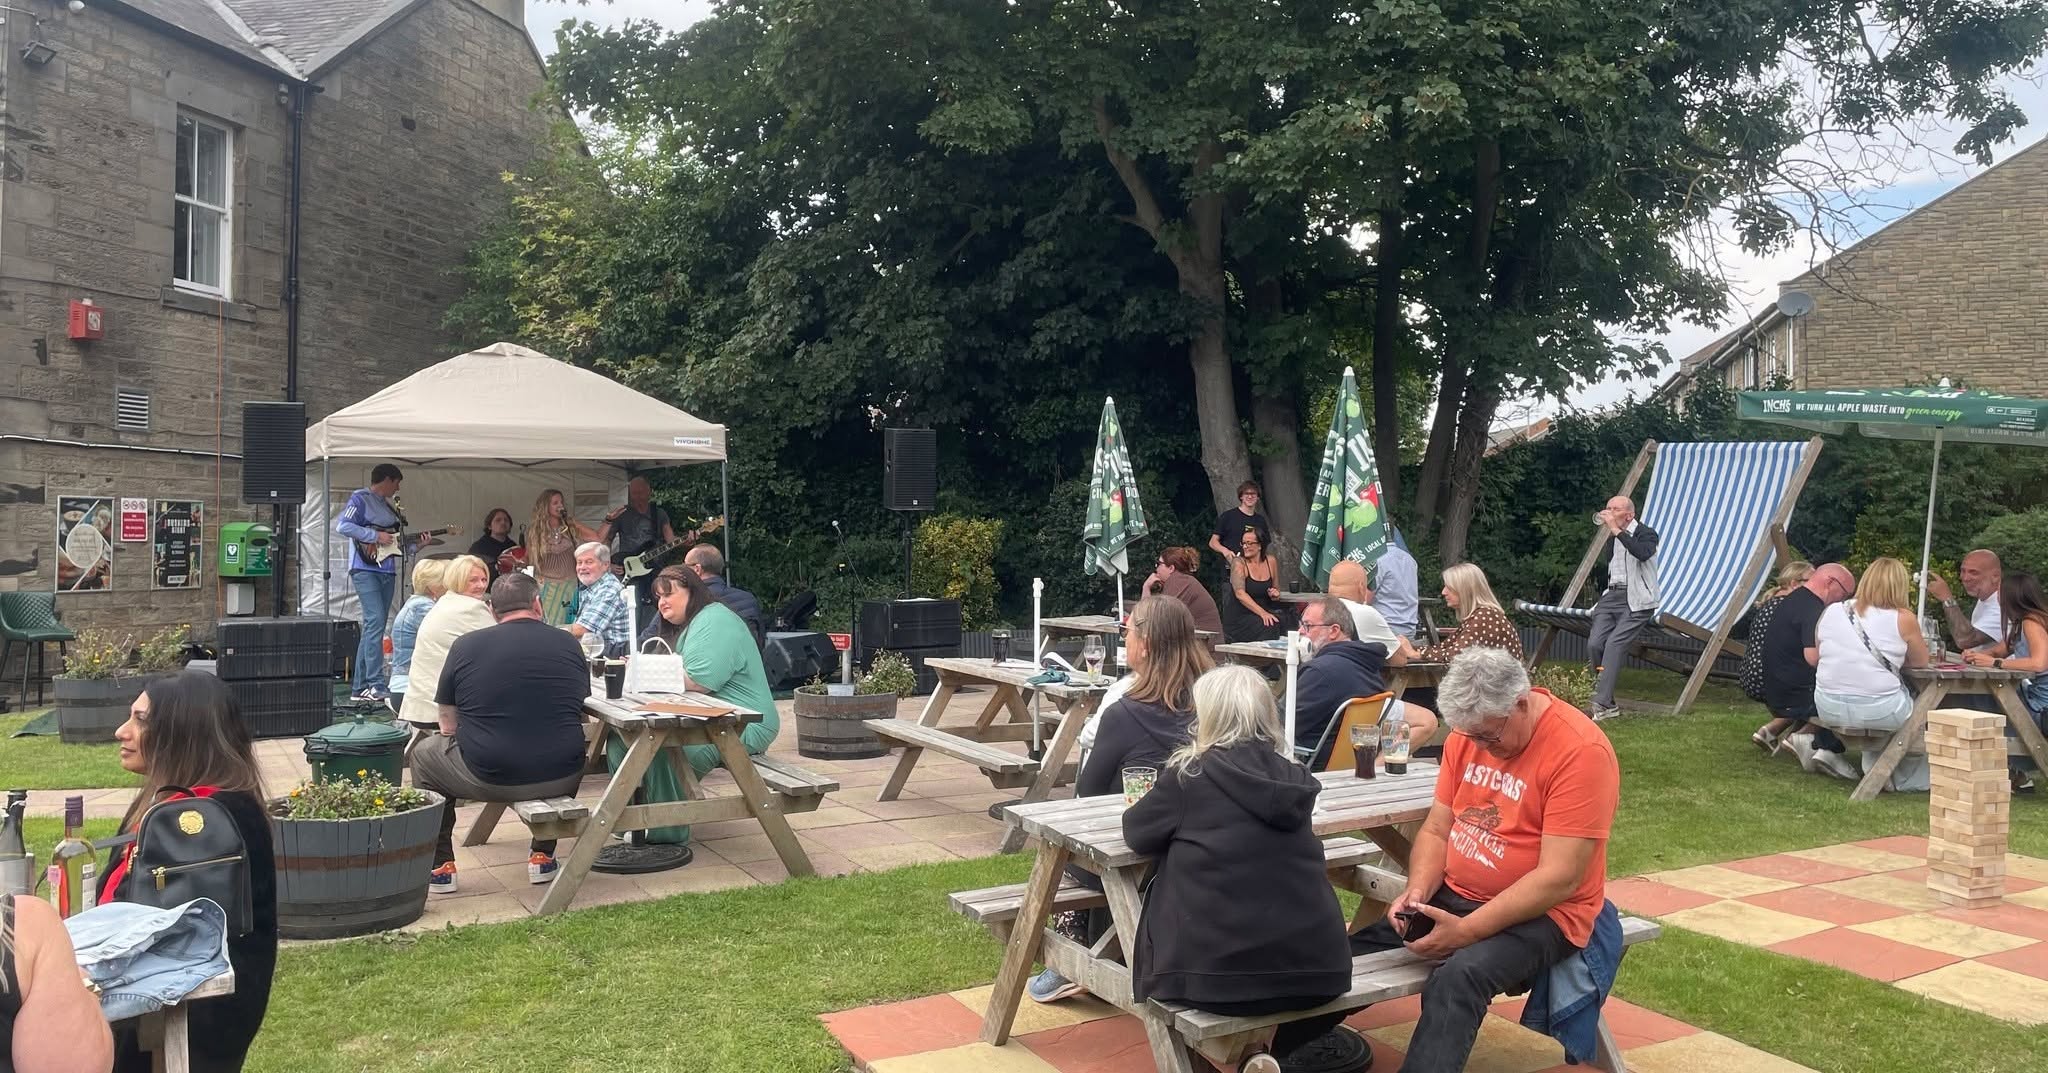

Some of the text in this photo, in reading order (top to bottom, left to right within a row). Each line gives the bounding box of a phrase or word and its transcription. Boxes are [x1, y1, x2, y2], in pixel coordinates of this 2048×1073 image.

[1795, 403, 1806, 411] WE
[1806, 403, 1823, 411] TURN
[1824, 403, 1835, 412] ALL
[1837, 403, 1861, 412] APPLE
[1862, 403, 1888, 414] WASTE
[1889, 406, 1905, 415] INTO
